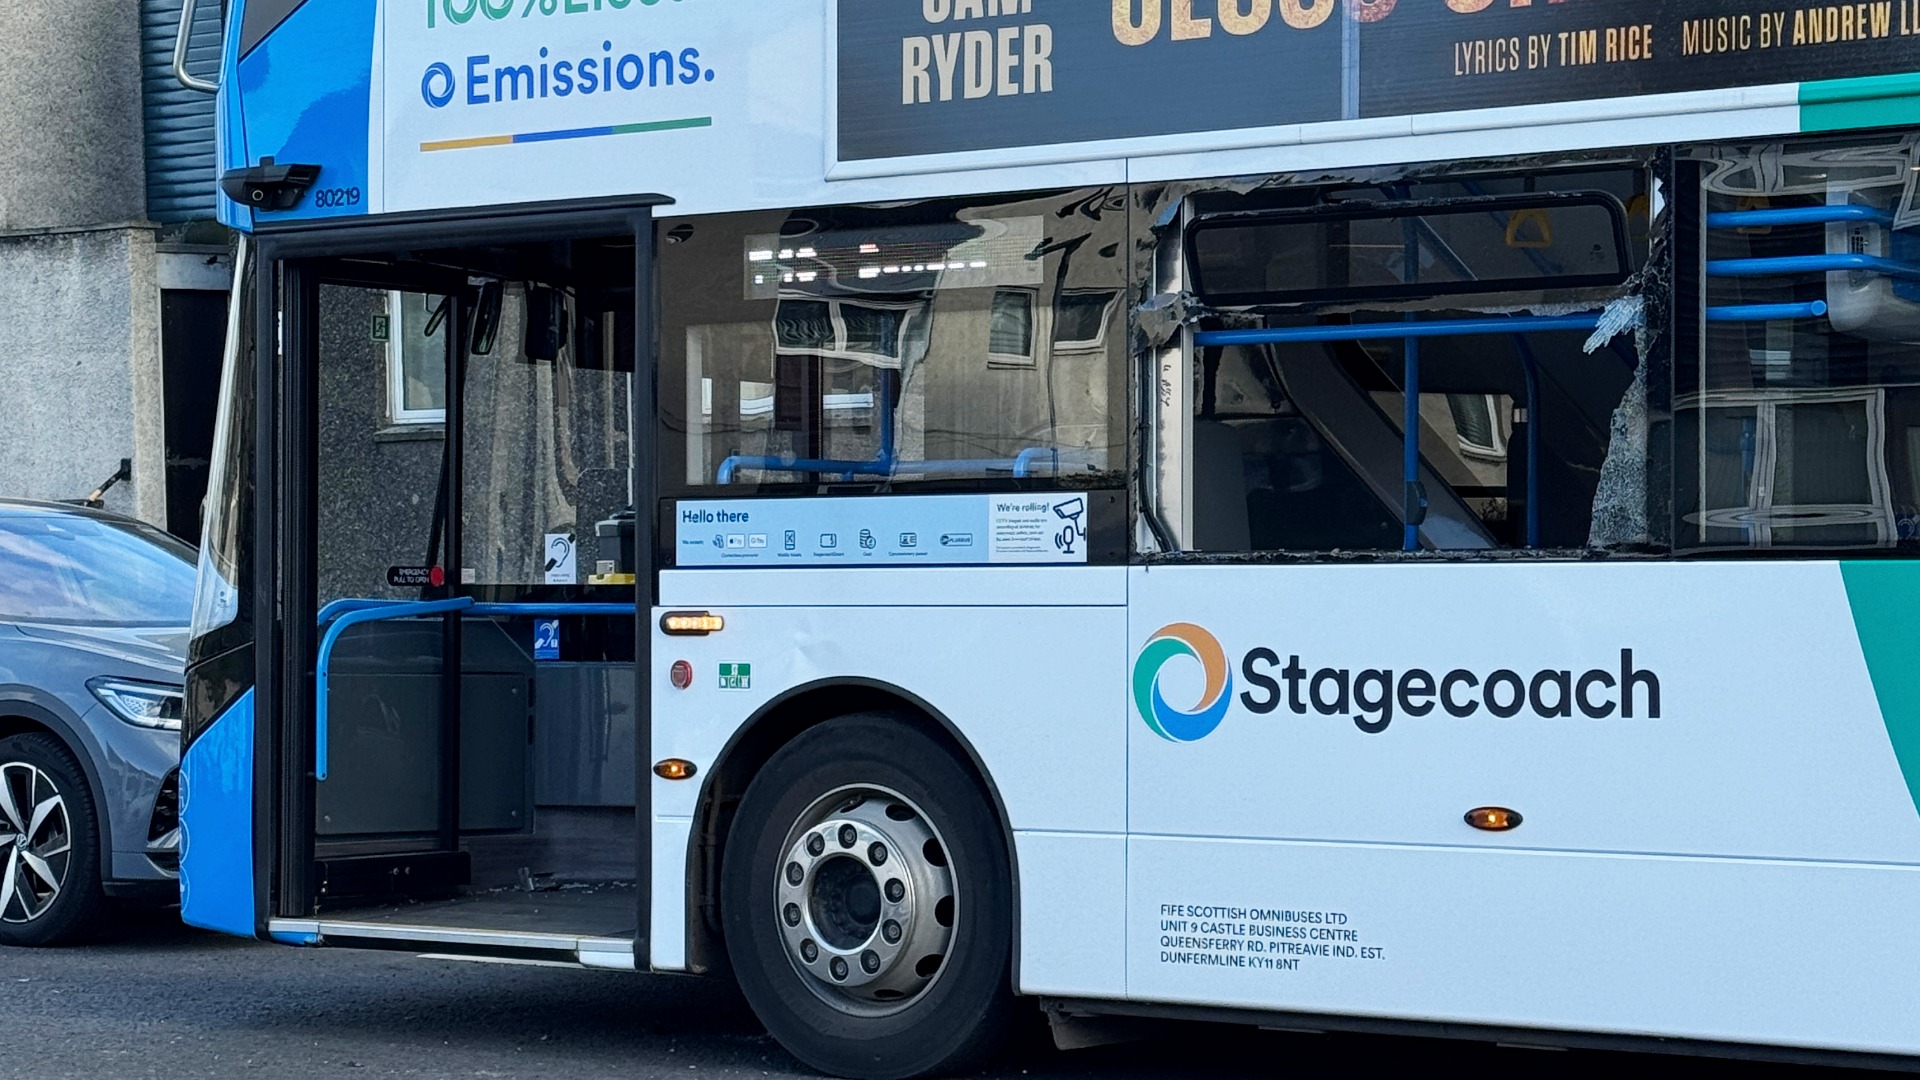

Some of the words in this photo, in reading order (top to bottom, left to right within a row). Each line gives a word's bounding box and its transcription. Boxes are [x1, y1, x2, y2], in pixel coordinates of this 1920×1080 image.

[1454, 37, 1519, 76] LYRICS
[1528, 34, 1551, 70] BY
[1558, 29, 1597, 66] TIM
[1605, 25, 1652, 62] RICE
[1682, 15, 1751, 56] MUSIC
[1760, 12, 1785, 48] BY
[1792, 1, 1891, 45] ANDREW
[467, 40, 715, 105] Emissions.
[902, 23, 1053, 105] RYDER
[315, 186, 360, 208] 80219
[682, 509, 714, 523] Hello
[716, 508, 749, 523] there
[996, 503, 1020, 513] We're
[1021, 502, 1050, 514] rolling!
[1240, 646, 1661, 735] Stagecoach
[1160, 904, 1185, 917] FIFE
[1186, 905, 1247, 920] SCOTTISH
[1250, 908, 1323, 925] OMNIBUSES
[1325, 912, 1348, 925] LTD
[1160, 920, 1187, 933] UNIT
[1190, 922, 1198, 934] 9
[1200, 922, 1246, 936] CASTLE
[1249, 924, 1307, 940] BUSINESS
[1309, 927, 1359, 943] CENTRE
[1160, 935, 1245, 952] QUEENSFERRY
[1247, 940, 1267, 953] RD.
[1269, 941, 1330, 957] PITREAVIE
[1332, 944, 1358, 958] IND.
[1360, 946, 1386, 960] EST.
[1160, 951, 1246, 968] DUNFERMLINE
[1248, 956, 1274, 970] KY11
[1275, 958, 1300, 971] 8NT
